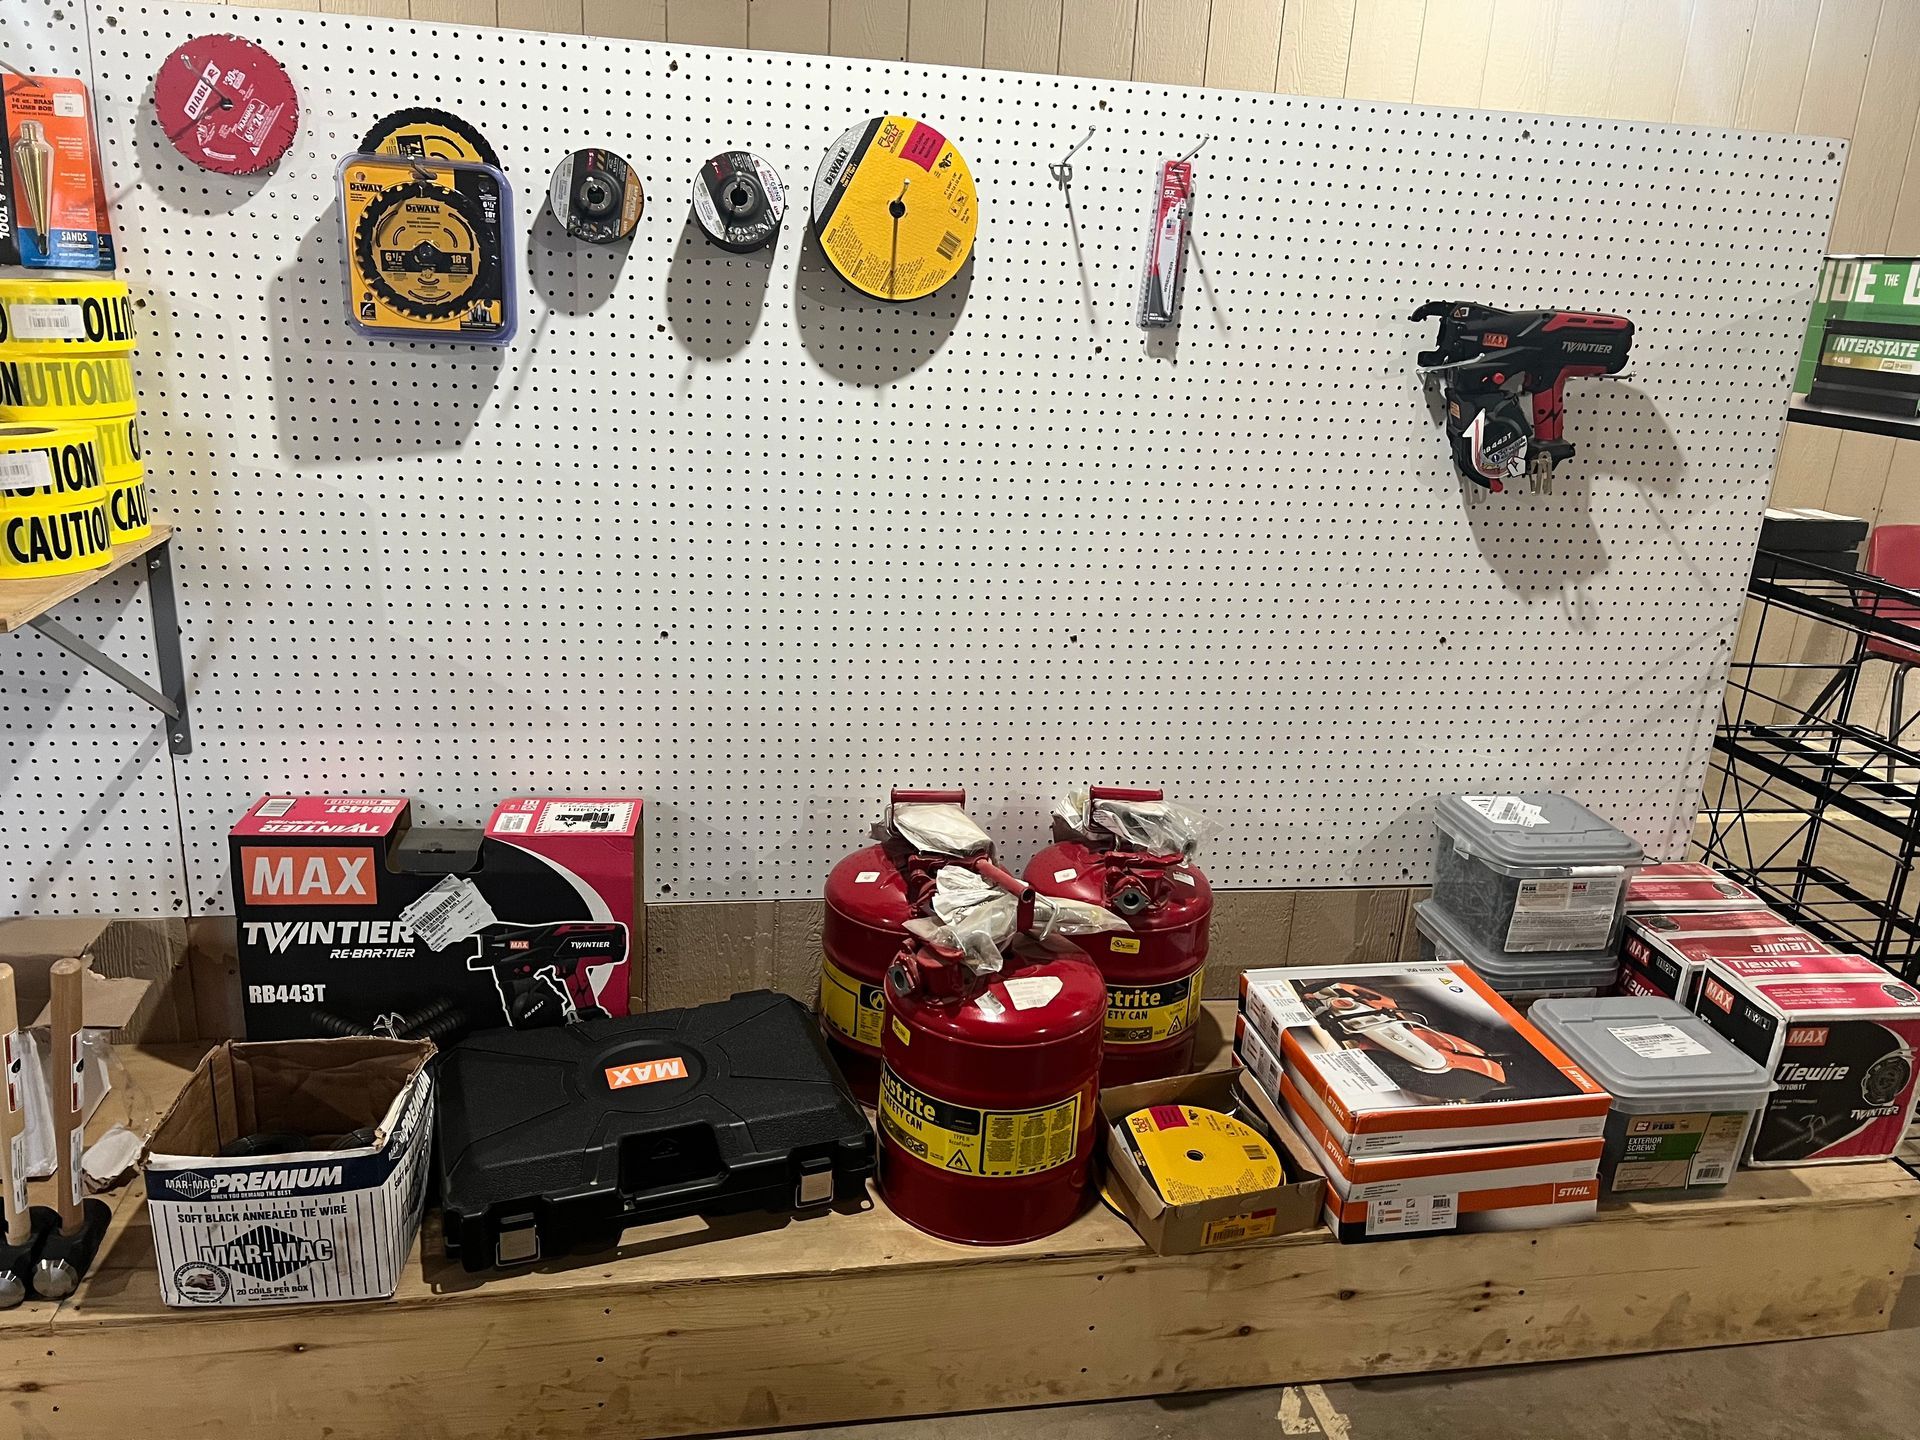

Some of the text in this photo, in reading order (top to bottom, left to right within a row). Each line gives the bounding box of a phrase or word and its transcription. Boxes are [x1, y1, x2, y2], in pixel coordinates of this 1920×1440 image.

[878, 120, 895, 148] FLEX
[883, 124, 901, 149] VOLT
[824, 147, 850, 187] DEWALT
[350, 183, 383, 192] DEWALT
[405, 204, 440, 213] DEWALT
[61, 231, 88, 241] SANDS
[451, 254, 467, 264] 18T
[1164, 261, 1174, 292] WRECKER
[1884, 273, 1900, 287] THE
[1483, 334, 1508, 346] MAX
[1561, 341, 1613, 354] TWINTIER
[1832, 337, 1919, 358] INTERSTATE
[325, 805, 396, 814] RB443T
[259, 823, 381, 834] TWINTIER
[252, 856, 368, 896] MAX
[242, 921, 415, 955] TWINTIER
[510, 941, 529, 949] MAX
[570, 941, 610, 950] TWINTIER
[1628, 940, 1650, 964] MAX
[1751, 941, 1820, 954] Tiewire
[1729, 959, 1802, 969] Tiewire
[248, 984, 326, 1004] RB443T
[1707, 983, 1733, 1009] MAX
[1128, 1010, 1148, 1020] CAN
[1789, 1029, 1827, 1044] MAX
[611, 1060, 680, 1086] MAX
[1566, 1069, 1593, 1089] STIHL
[1777, 1062, 1850, 1081] Tiewire
[881, 1062, 936, 1122] Justrite
[1327, 1095, 1345, 1121] STIHL
[1851, 1105, 1899, 1121] TWINTIER
[905, 1112, 923, 1131] CAN
[1652, 1122, 1675, 1130] PLUS
[1626, 1144, 1657, 1152] SCREWS
[1628, 1136, 1663, 1145] EXTERIOR
[1326, 1140, 1344, 1168] STIHL
[165, 1165, 343, 1195] MAR-MAC PREMIUM
[241, 1191, 265, 1199] DEMAND
[1557, 1186, 1591, 1197] STIHL
[177, 1204, 348, 1224] SOFT BLACK ANNEALED TIE WIRE
[200, 1238, 334, 1267] MAR-MAC
[236, 1284, 309, 1296] 20 COILS PER BOX
